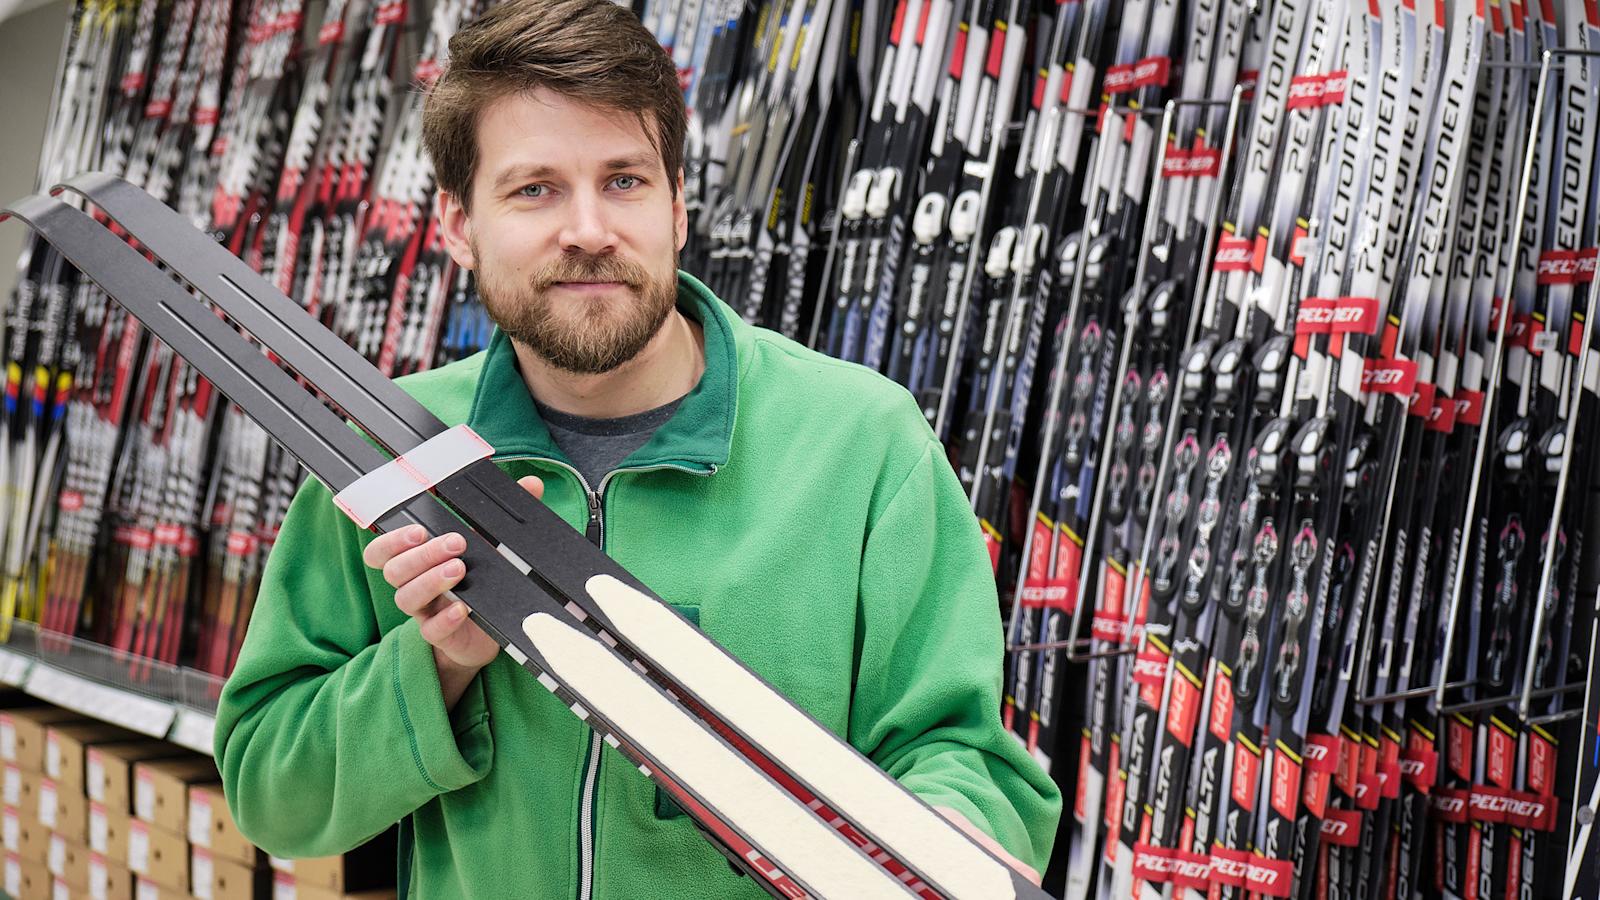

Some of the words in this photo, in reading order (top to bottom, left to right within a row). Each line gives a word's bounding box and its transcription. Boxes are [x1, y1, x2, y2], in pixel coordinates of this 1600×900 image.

[1324, 79, 1366, 277] PELTONEN
[1358, 71, 1398, 273] PELTONEN
[1414, 80, 1463, 279] PELTONEN
[1454, 92, 1490, 279] PELTONEN
[1558, 85, 1586, 250] ELTONEN
[1169, 676, 1186, 732] 140
[1214, 677, 1231, 734] 140
[1123, 712, 1148, 832] DELTA
[1235, 749, 1249, 800] 120
[1275, 755, 1289, 809] 120
[1492, 731, 1505, 781] 120
[1532, 737, 1545, 788] 120
